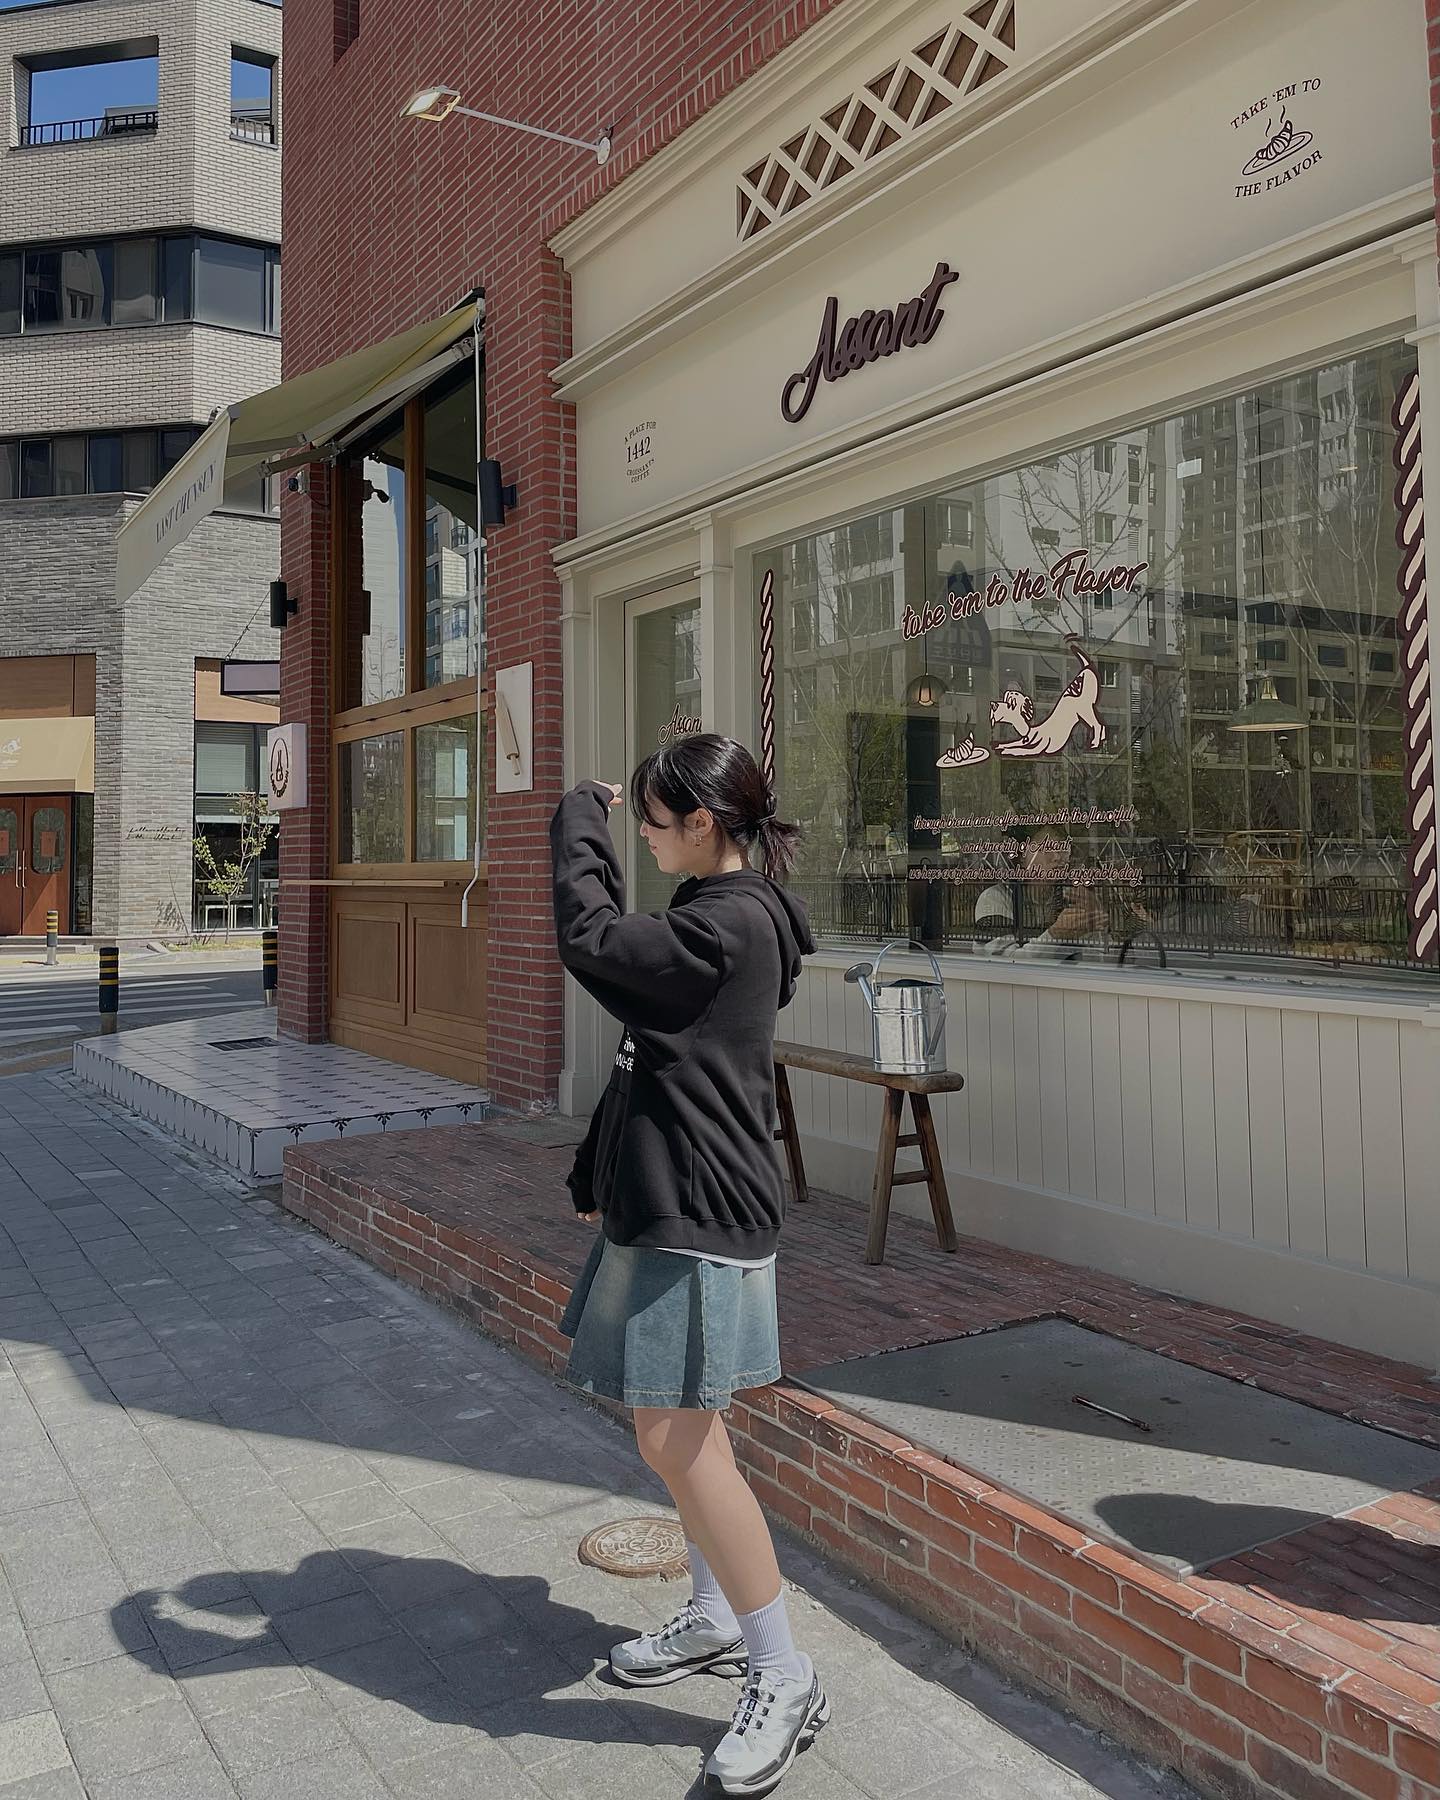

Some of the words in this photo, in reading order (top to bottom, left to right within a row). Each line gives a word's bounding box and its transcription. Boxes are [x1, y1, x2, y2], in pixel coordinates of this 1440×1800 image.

[1230, 97, 1268, 129] TAKE
[1302, 78, 1321, 92] TO
[1234, 182, 1262, 198] THE
[1266, 150, 1323, 190] FLAVOR
[781, 262, 960, 423] Assant
[628, 423, 645, 439] PLACE
[627, 436, 651, 463] 1442
[631, 470, 650, 483] COFFEE
[902, 602, 946, 641] take
[986, 573, 1008, 608] to
[1012, 567, 1047, 604] the
[1049, 549, 1149, 600] Flavor
[658, 703, 702, 745] Assan
[947, 812, 975, 829] bread
[975, 811, 994, 828] and
[993, 809, 1019, 831] coffee
[1019, 810, 1047, 826] made
[1047, 808, 1069, 824] with
[1070, 807, 1088, 823] the
[1085, 804, 1134, 828] flavorful
[961, 838, 982, 853] and
[1019, 836, 1031, 857] of
[1046, 863, 1069, 880] and
